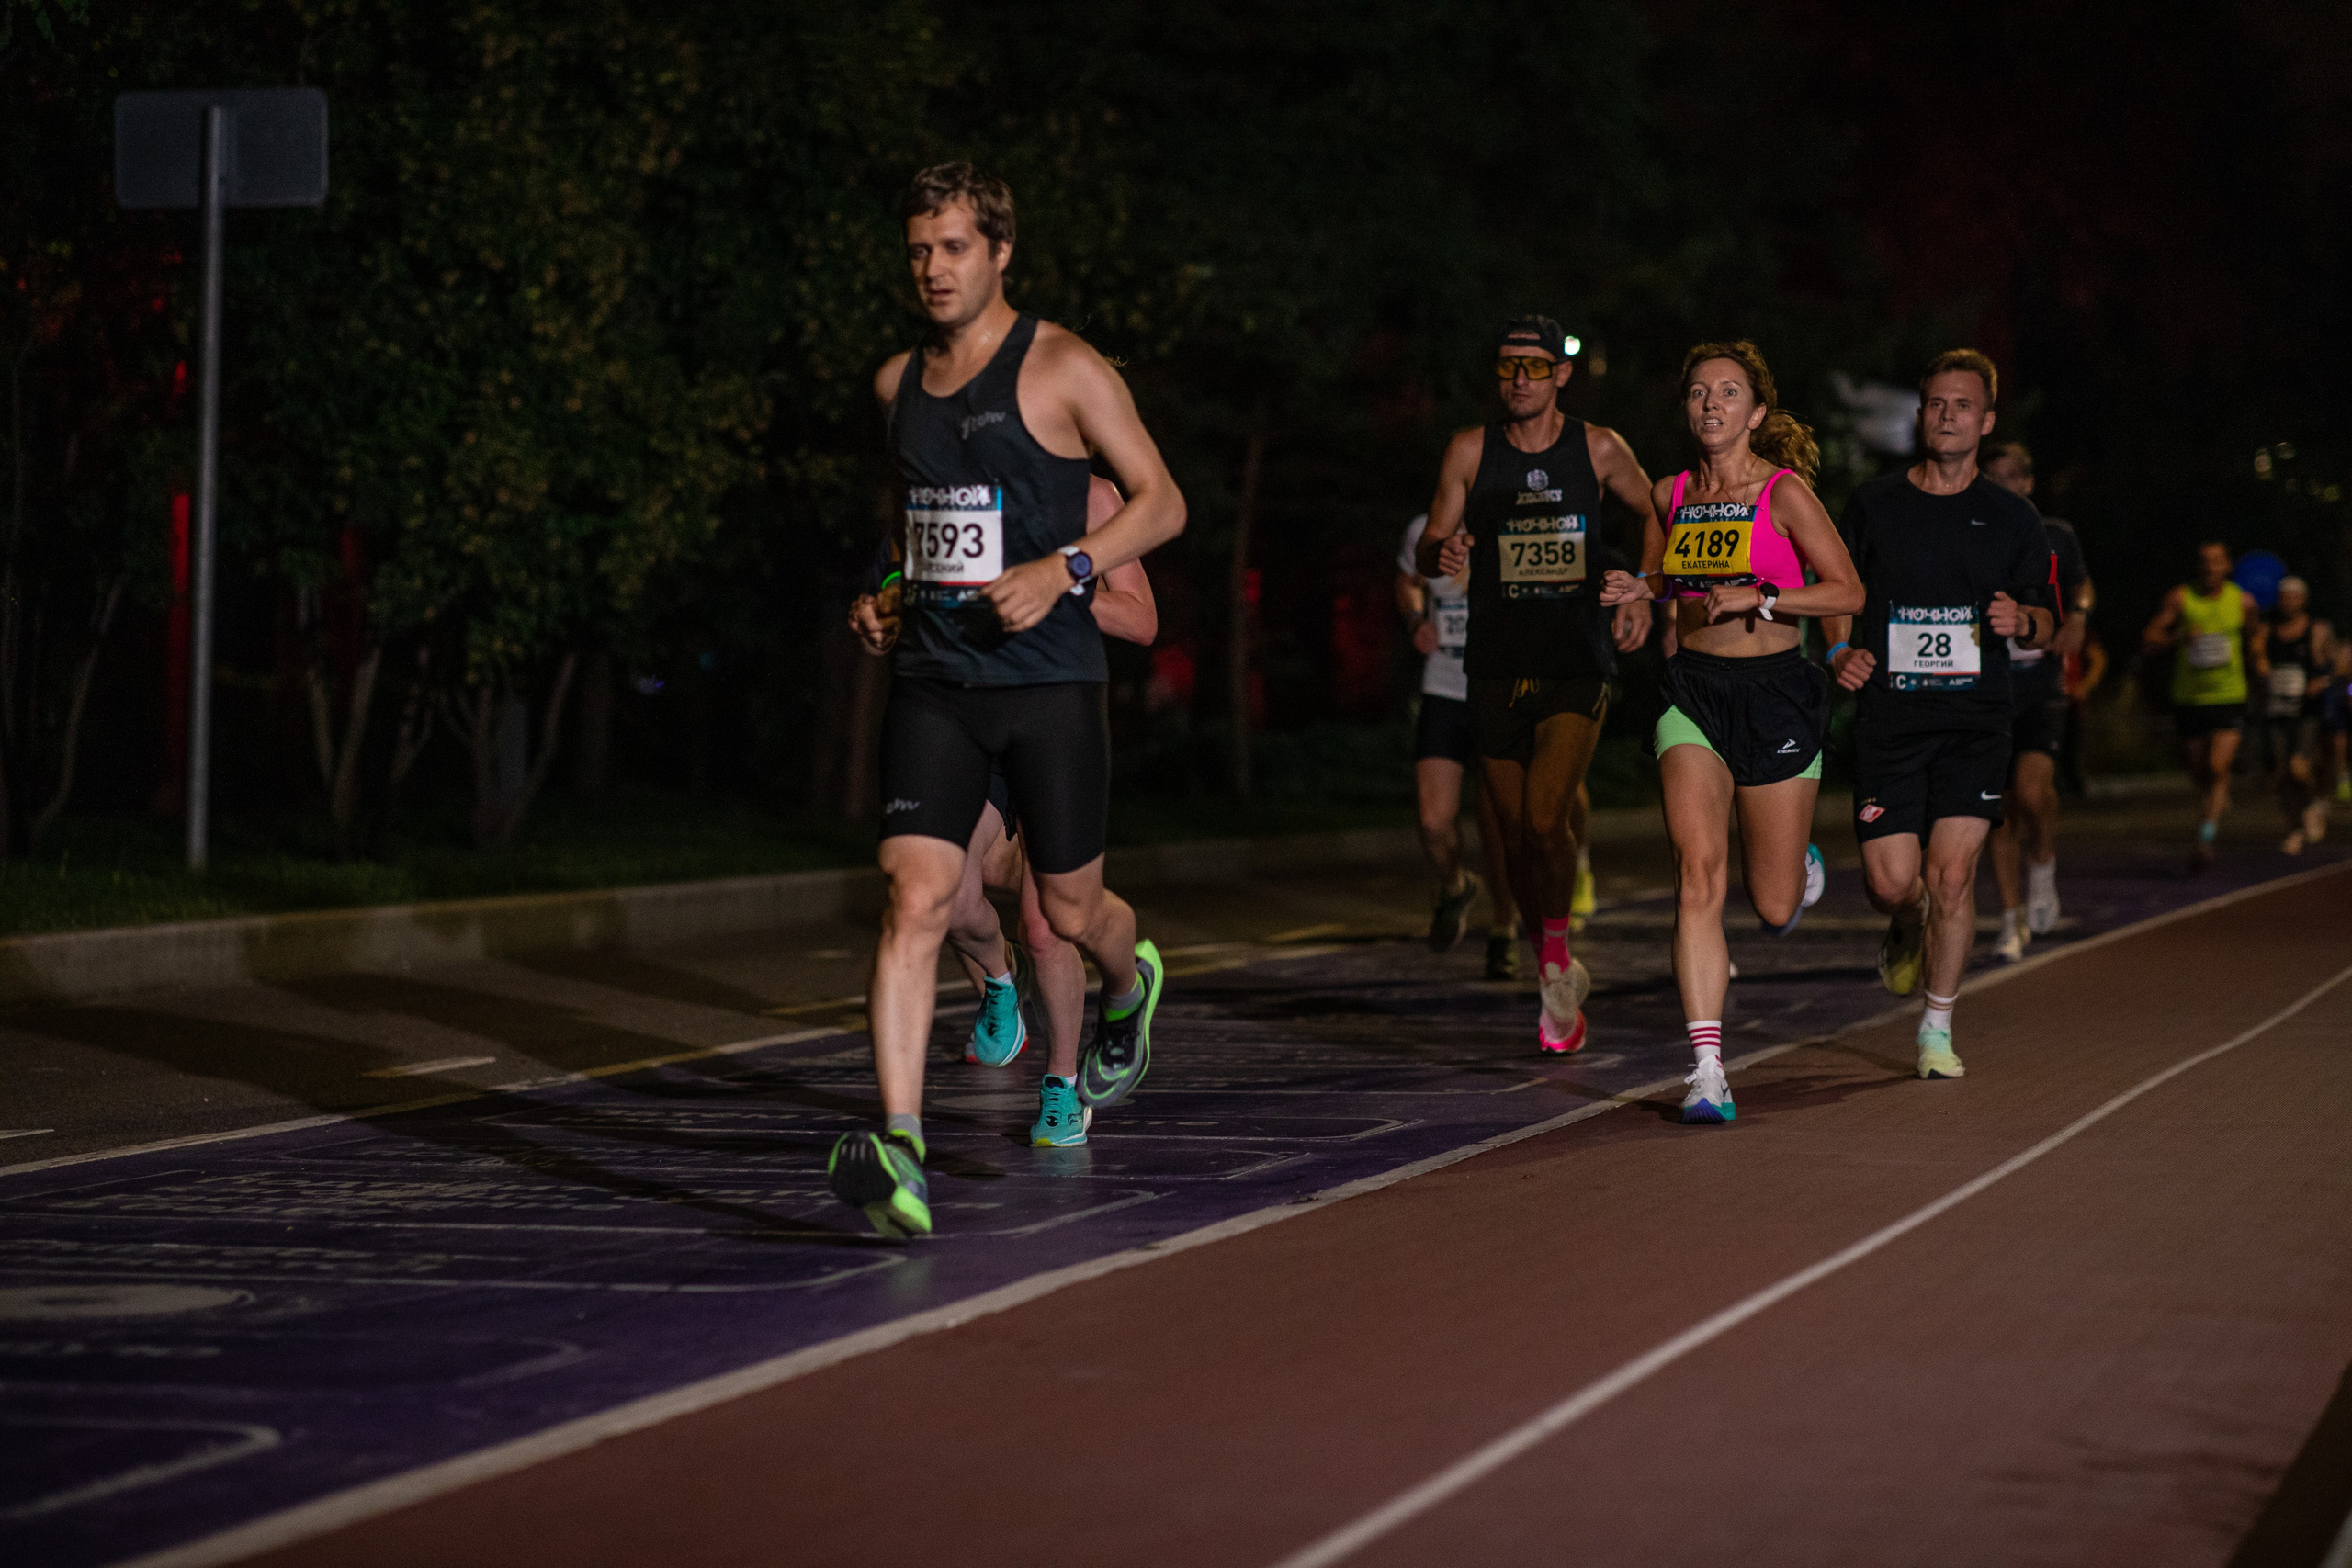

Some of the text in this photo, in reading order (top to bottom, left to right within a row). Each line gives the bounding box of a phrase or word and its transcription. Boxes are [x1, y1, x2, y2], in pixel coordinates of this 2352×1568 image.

[914, 522, 984, 558] 7593
[1674, 529, 1740, 558] 4189
[1511, 541, 1576, 567] 7358
[1681, 560, 1731, 570] ЕКАТЕРИНА
[1918, 633, 1951, 657] 28
[1914, 659, 1954, 669] ГЕОРГИЙ
